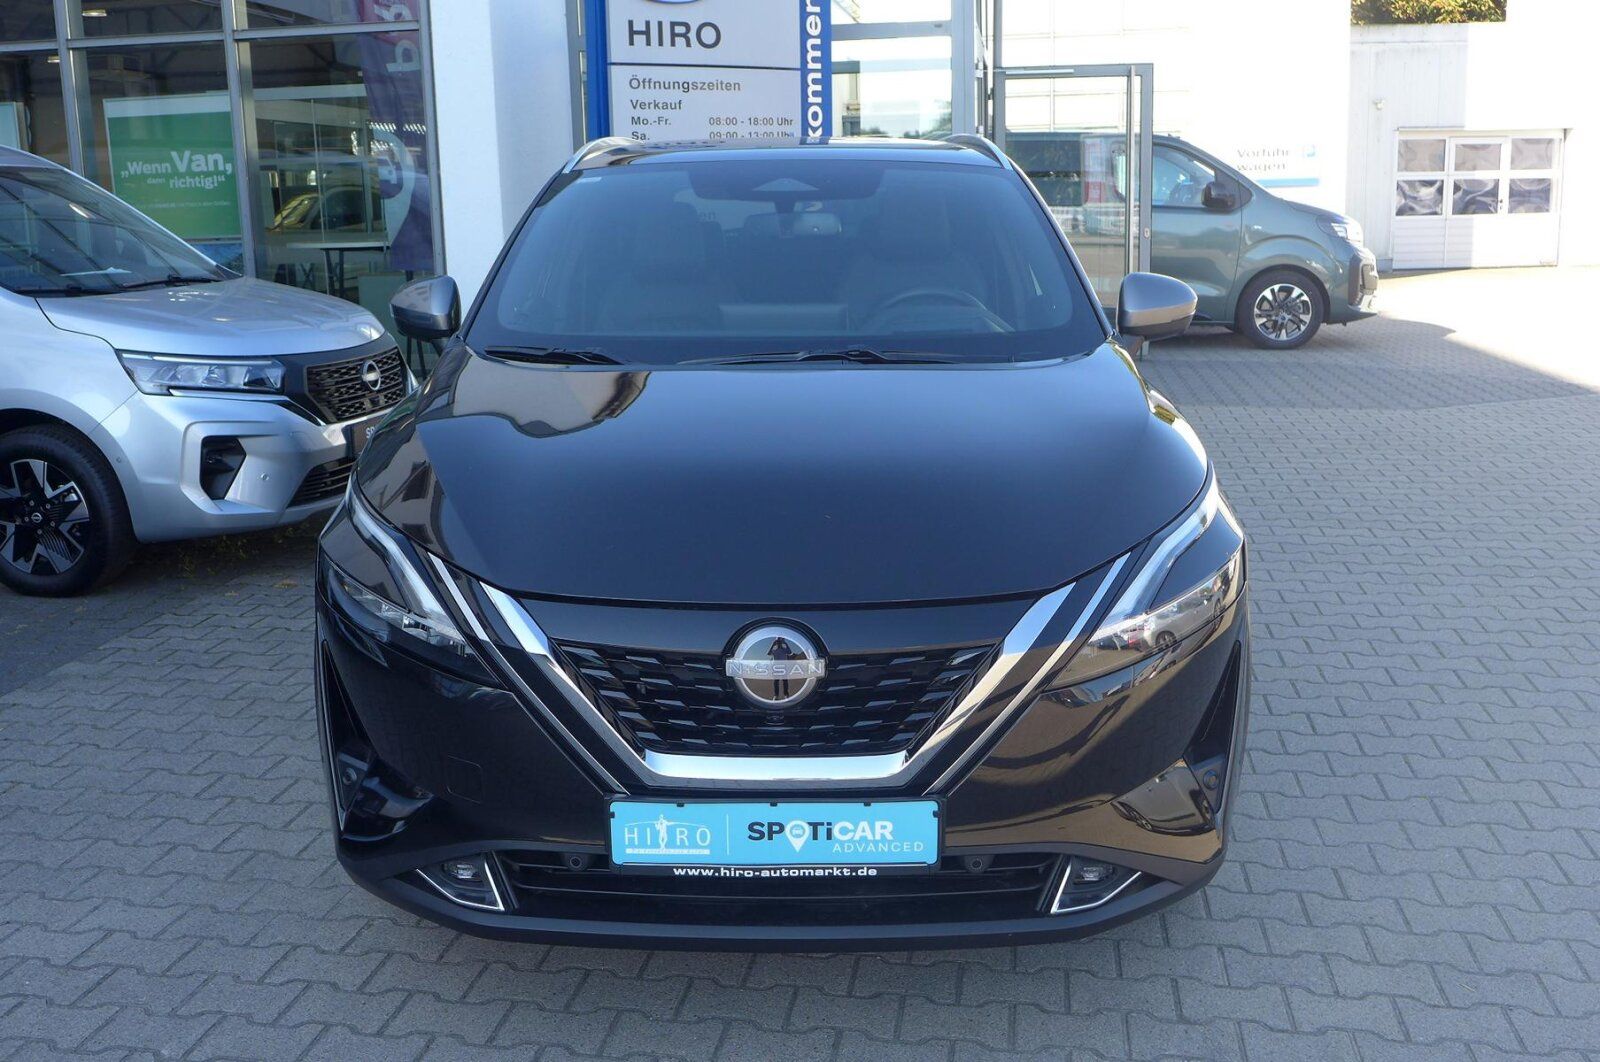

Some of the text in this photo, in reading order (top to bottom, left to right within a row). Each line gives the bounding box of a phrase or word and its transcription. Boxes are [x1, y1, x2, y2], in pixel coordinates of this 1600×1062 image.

[628, 19, 721, 49] HIRO
[629, 75, 741, 93] Öffnungszeiten
[630, 99, 683, 111] Verkauf
[631, 116, 672, 126] Mo.-Fr.
[708, 116, 738, 126] 08:00
[748, 116, 774, 127] 18:00
[776, 117, 794, 127] Uhr
[631, 131, 651, 141] Sa.
[120, 150, 233, 179] „Wenn Van,
[729, 664, 822, 676] NISSAN
[624, 827, 712, 846] HIRO
[832, 841, 924, 853] ADVANCED
[673, 866, 878, 877] www.hiro-automarkt.de
